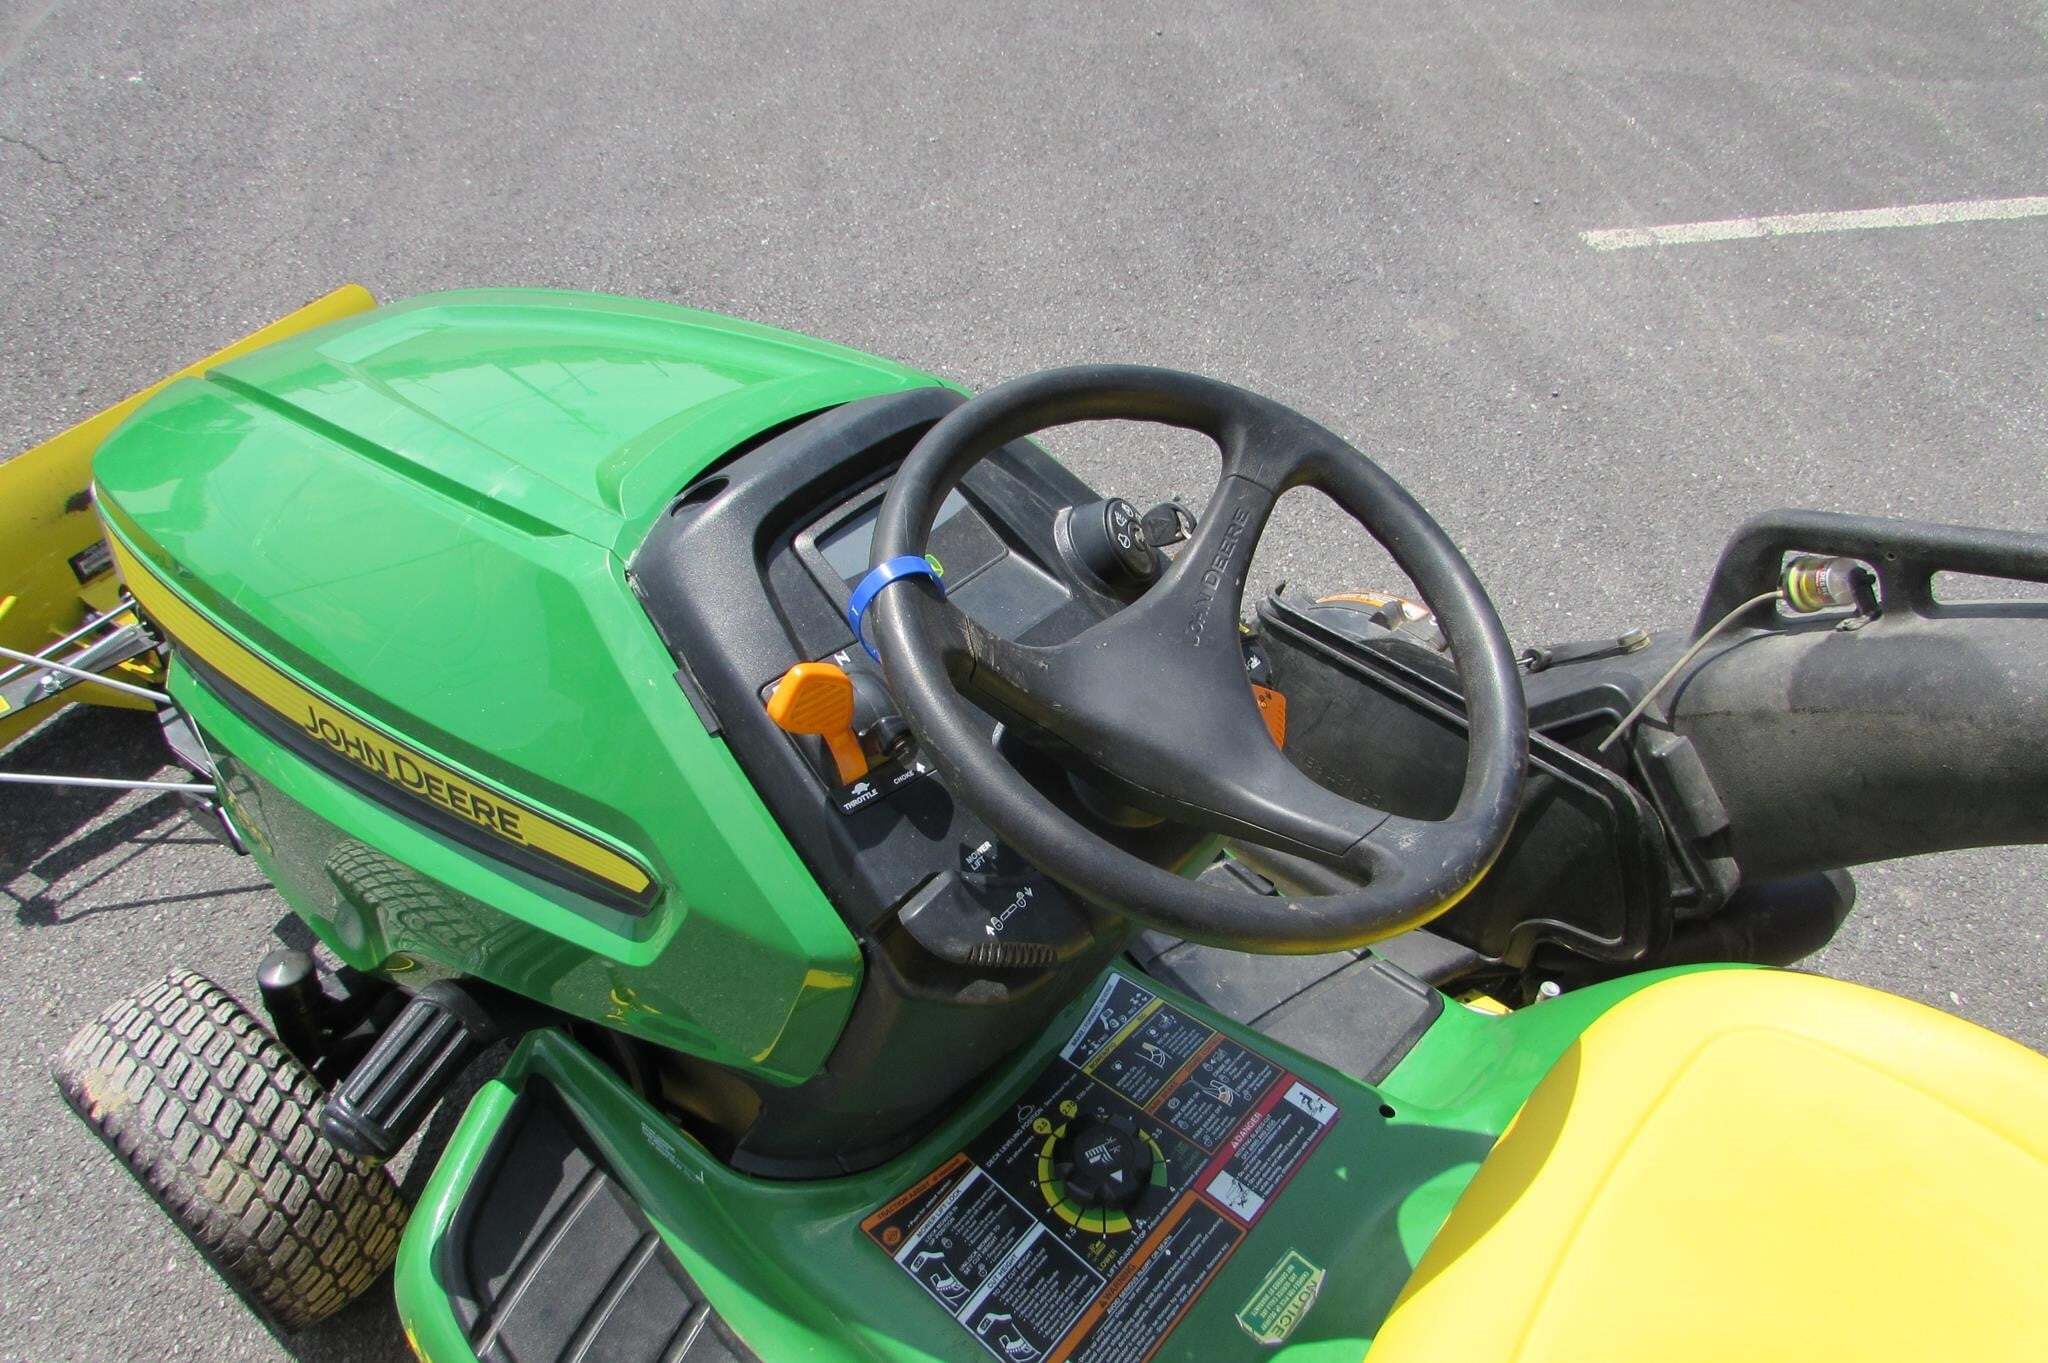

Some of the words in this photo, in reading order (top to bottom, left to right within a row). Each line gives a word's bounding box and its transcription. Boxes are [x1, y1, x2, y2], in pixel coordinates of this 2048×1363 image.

[1203, 506, 1251, 590] DEERE
[304, 704, 390, 776] JOHN
[391, 751, 525, 840] DEERE
[893, 770, 914, 785] CHOKE
[843, 787, 879, 811] THROTTLE
[966, 841, 992, 864] MOWER
[971, 855, 985, 871] LIFT
[984, 1151, 1002, 1167] DECK
[997, 1127, 1024, 1153] LEVELING
[1020, 1106, 1045, 1130] POSITION
[1234, 1111, 1262, 1143] DANGER
[915, 1213, 938, 1238] MOWER
[934, 1202, 948, 1217] LIFT
[945, 1187, 962, 1205] LOCK
[1063, 1225, 1079, 1241] 1.5
[985, 1273, 1001, 1289] CUT
[997, 1252, 1019, 1276] HEIGHT
[1095, 1247, 1120, 1271] LOWER
[1106, 1264, 1119, 1278] LIFT
[1116, 1243, 1136, 1266] ADJUST
[1132, 1228, 1148, 1246] STOP
[1101, 1260, 1137, 1302] WARNING
[1269, 1279, 1320, 1338] NOTICE
